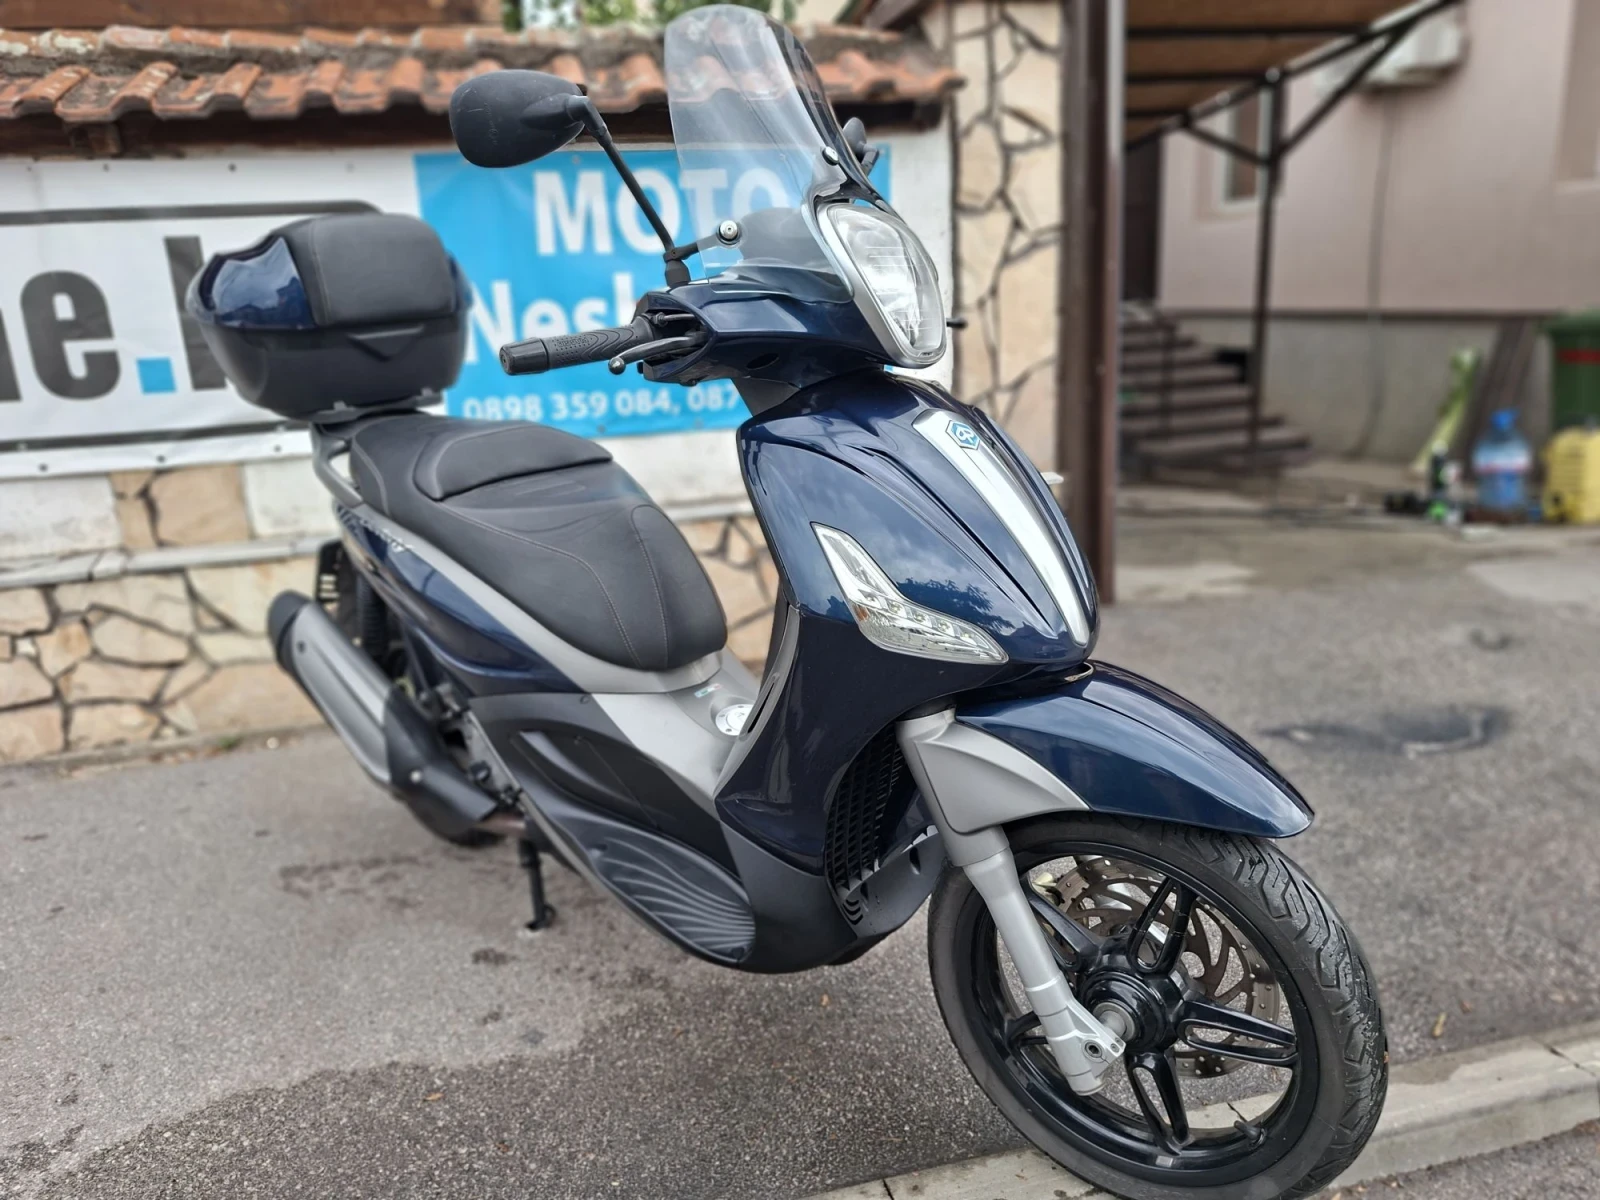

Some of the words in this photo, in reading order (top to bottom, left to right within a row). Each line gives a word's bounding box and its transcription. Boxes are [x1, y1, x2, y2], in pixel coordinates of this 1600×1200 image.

[462, 393, 543, 421] 0898
[549, 390, 607, 420] 359
[615, 387, 680, 416] 084,
